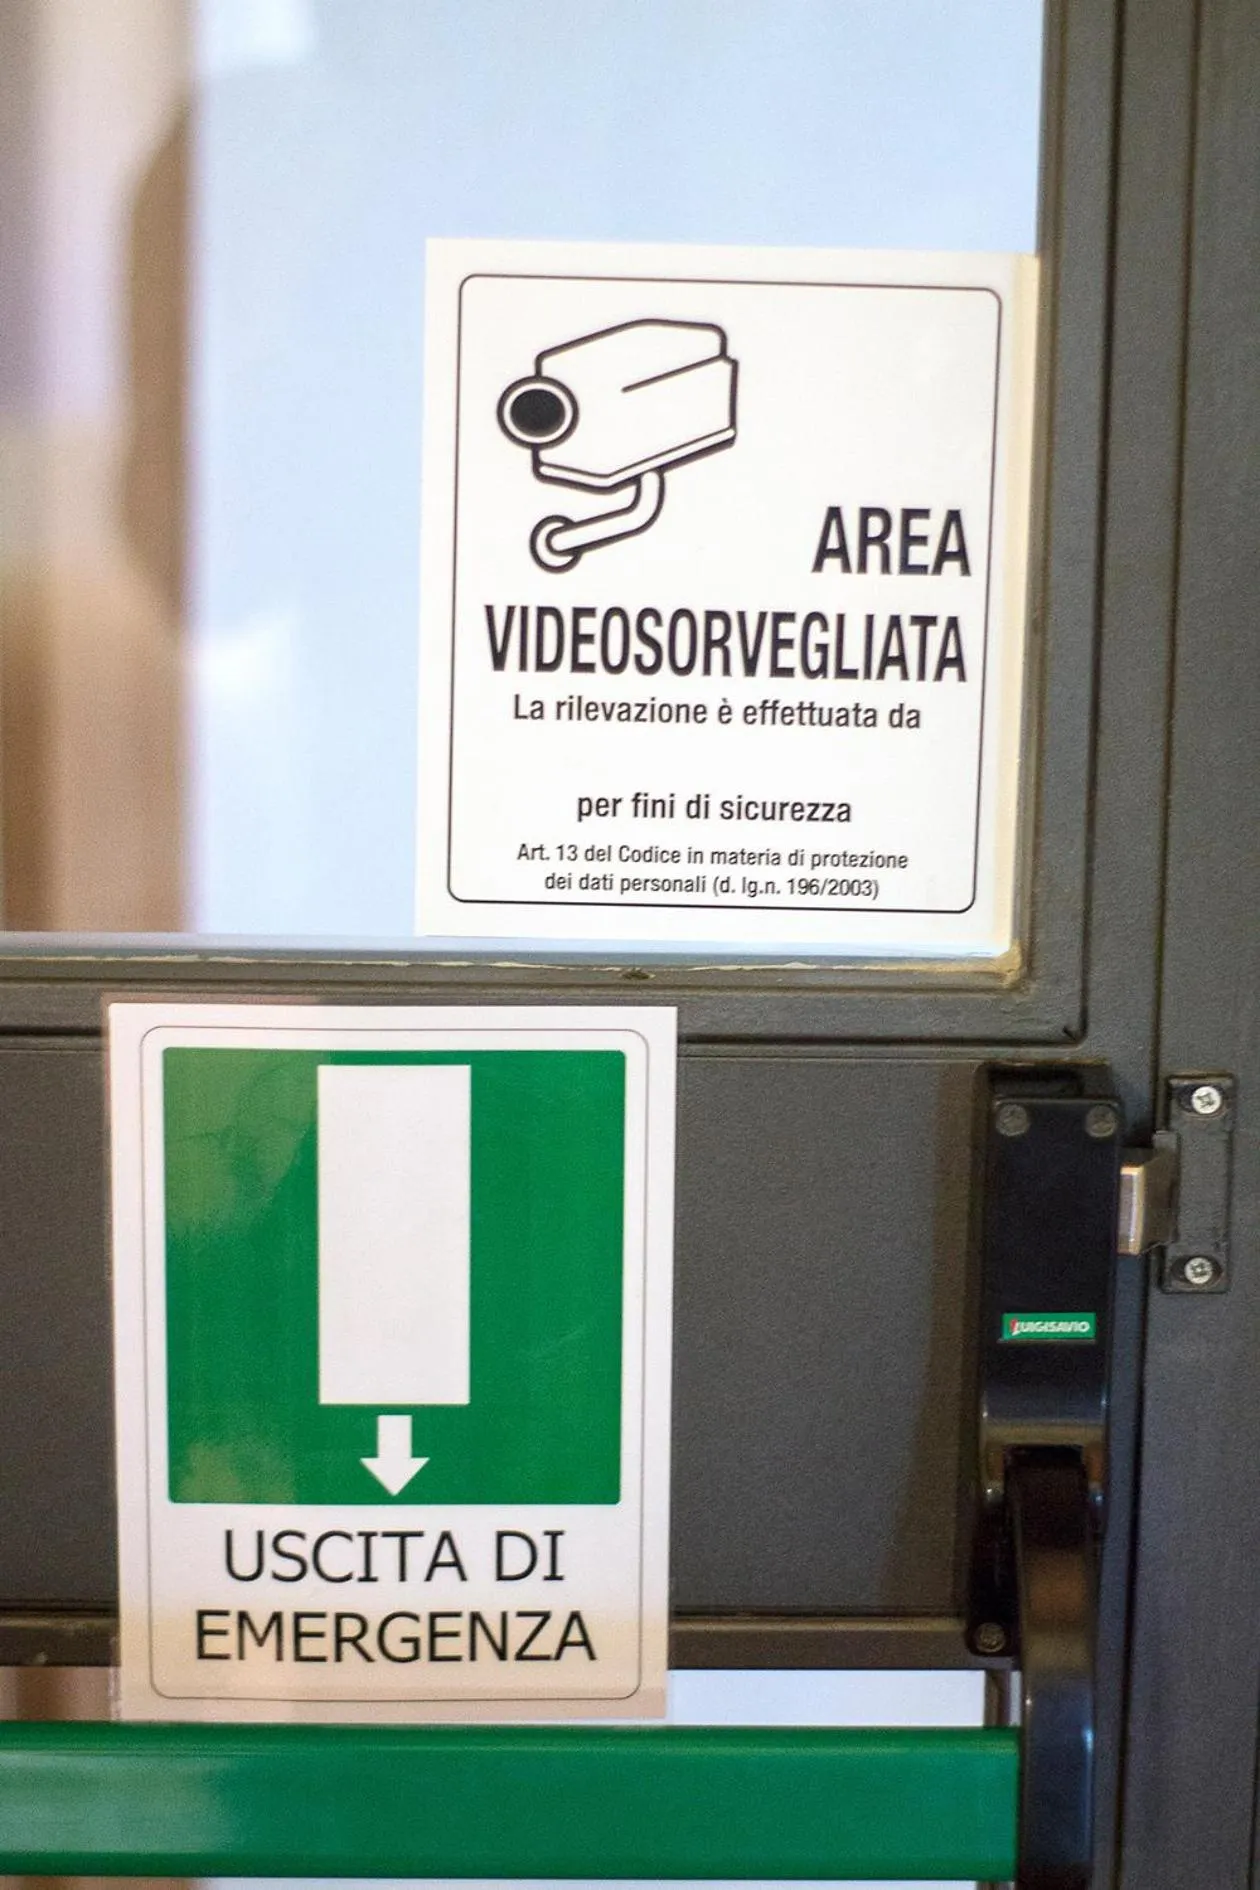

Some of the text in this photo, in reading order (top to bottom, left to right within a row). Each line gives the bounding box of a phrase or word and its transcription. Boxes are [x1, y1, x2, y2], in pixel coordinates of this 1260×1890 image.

[812, 505, 971, 577] AREA
[484, 604, 967, 683] VIDEOSORVEGLIATA
[514, 694, 921, 729] La rilevazione è effettuata da
[577, 793, 852, 823] per fini di sicurezza
[517, 843, 908, 872] Art. 13 del Codice in materia di protezione
[544, 872, 572, 891] dei
[578, 873, 614, 892] dati
[620, 874, 707, 897] personali
[712, 876, 737, 896] (d.
[787, 877, 880, 900] 196/2003)
[225, 1529, 566, 1584] USCITA DI
[195, 1609, 597, 1664] EMERGENZA
